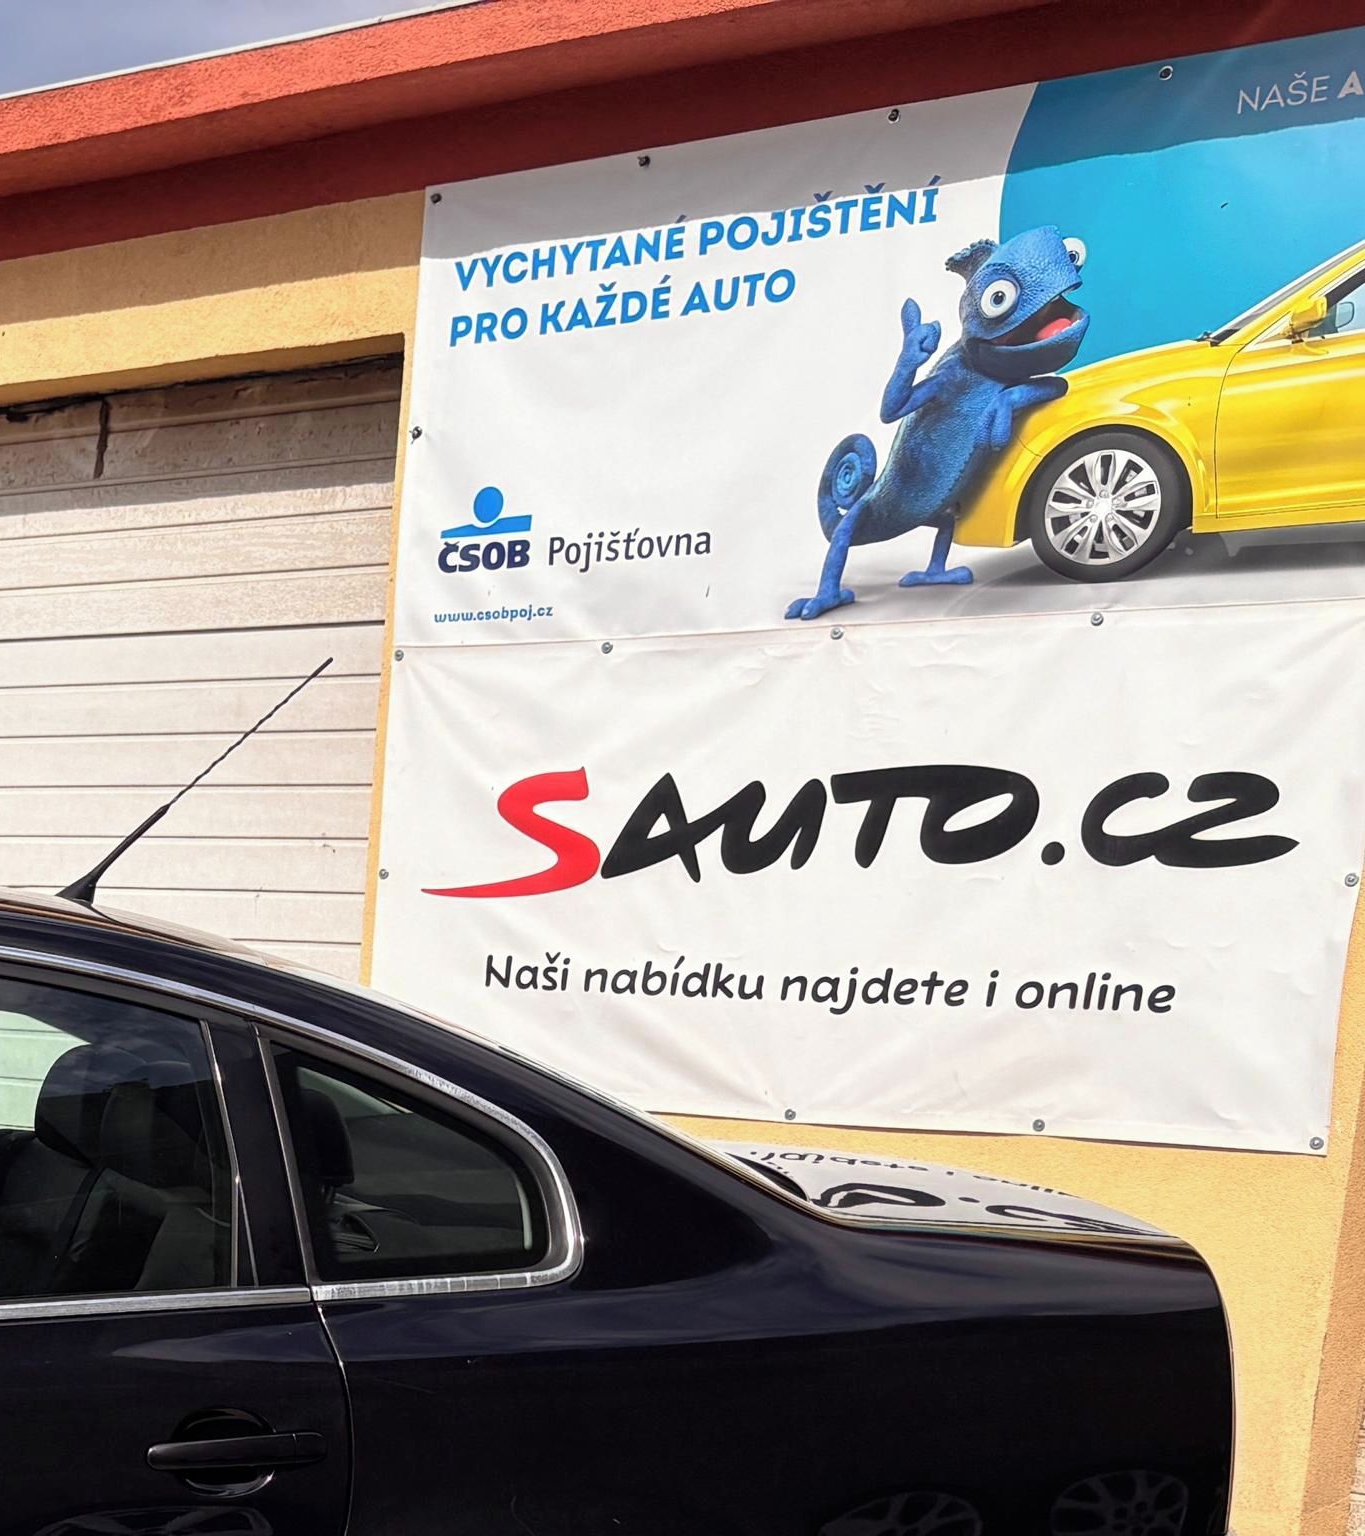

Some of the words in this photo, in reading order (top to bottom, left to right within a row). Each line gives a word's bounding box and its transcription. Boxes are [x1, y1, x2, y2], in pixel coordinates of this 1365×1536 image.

[1236, 70, 1331, 115] NAŠE
[454, 214, 688, 293] VYCHYTANÉ
[698, 175, 942, 256] POJIŠTĚNÍ
[448, 307, 529, 347] PRO
[538, 273, 673, 336] KAŽDÉ
[680, 268, 797, 317] AUTO
[437, 539, 532, 574] ČSOB
[547, 527, 712, 574] Pojišťovna
[433, 604, 554, 624] www.csobpoj.cz
[420, 764, 1300, 898] SAUTO.CZ
[484, 951, 570, 992] Naši
[583, 953, 765, 1000] nabídku
[779, 966, 970, 1016] najdete
[984, 968, 1000, 1008] i
[1014, 972, 1177, 1014] online
